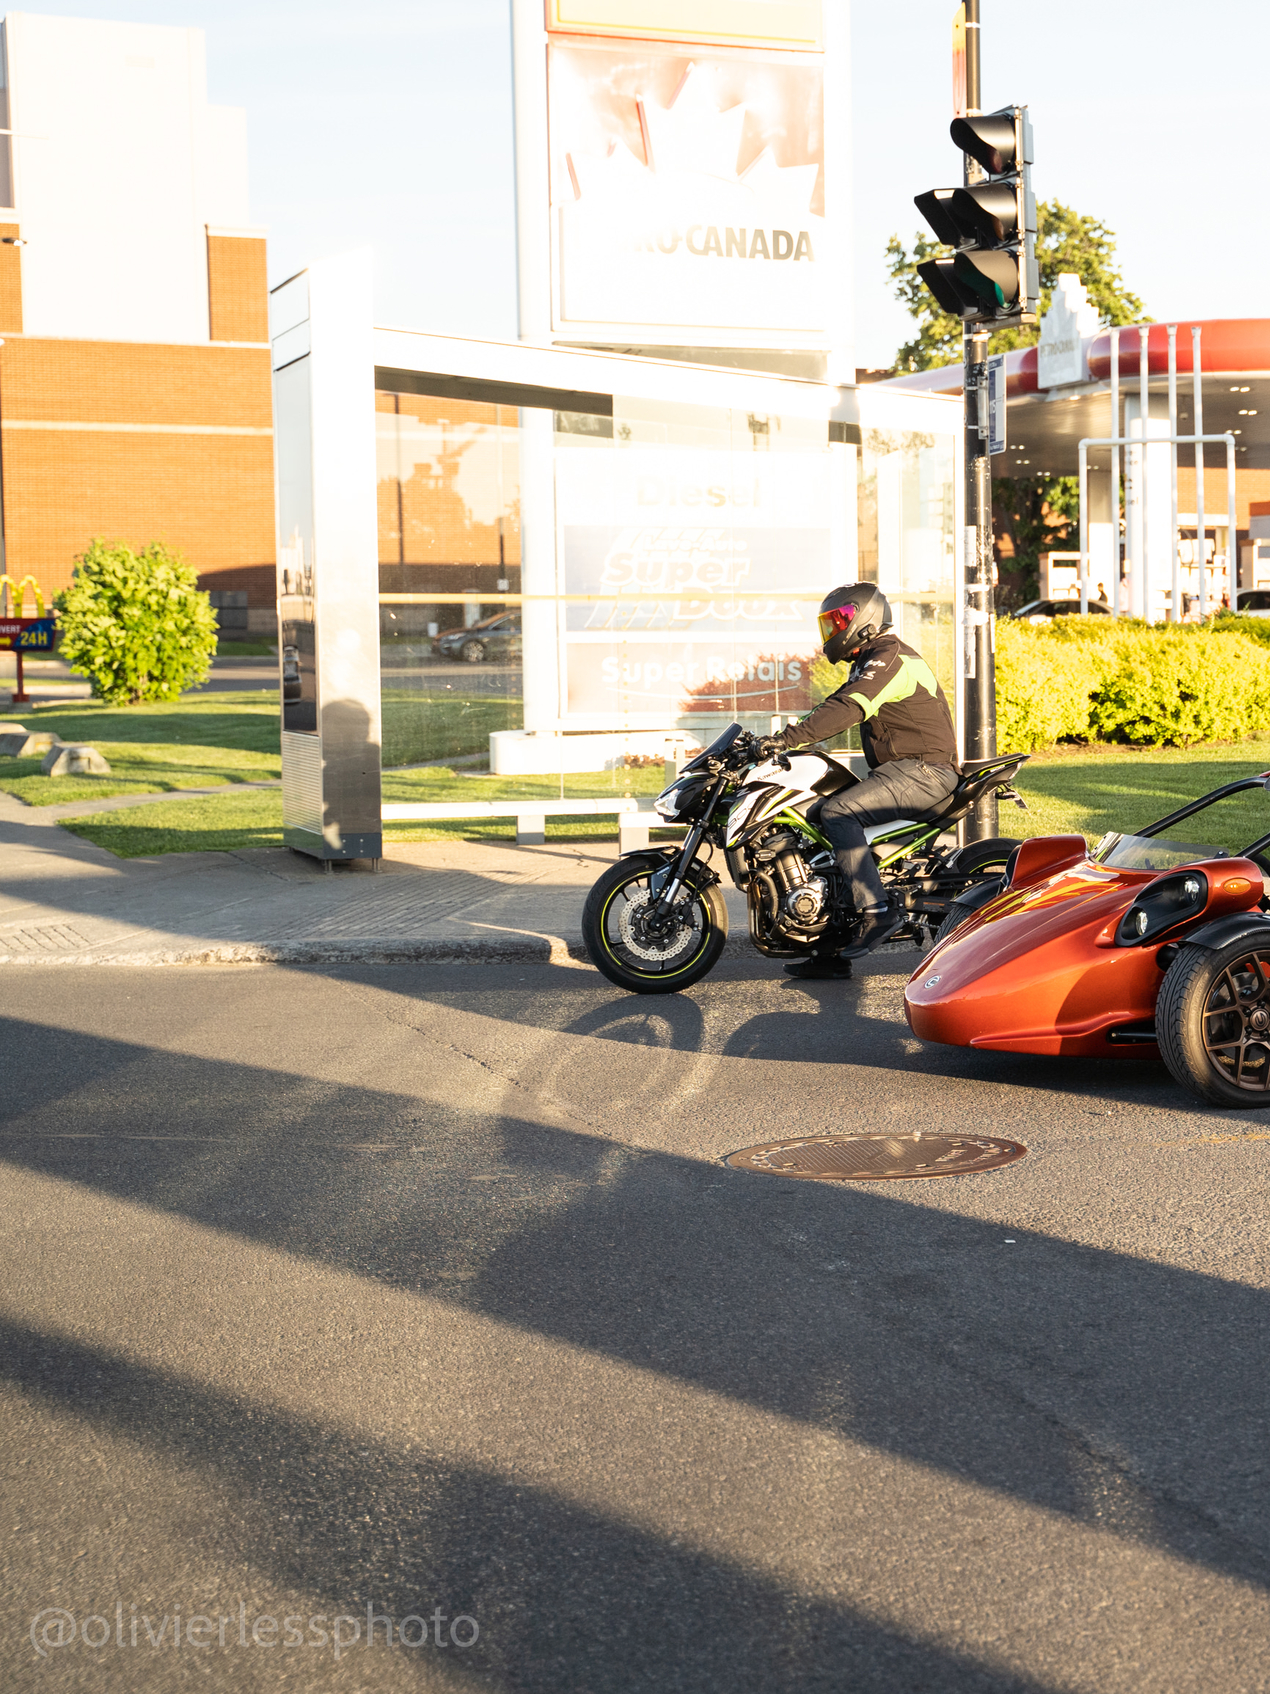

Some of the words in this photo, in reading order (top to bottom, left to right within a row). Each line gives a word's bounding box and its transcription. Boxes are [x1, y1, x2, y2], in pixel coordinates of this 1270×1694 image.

[602, 552, 749, 589] Super
[0, 624, 21, 634] VERT
[20, 631, 48, 646] 24H
[601, 656, 699, 690] Super
[707, 654, 802, 682] Relais
